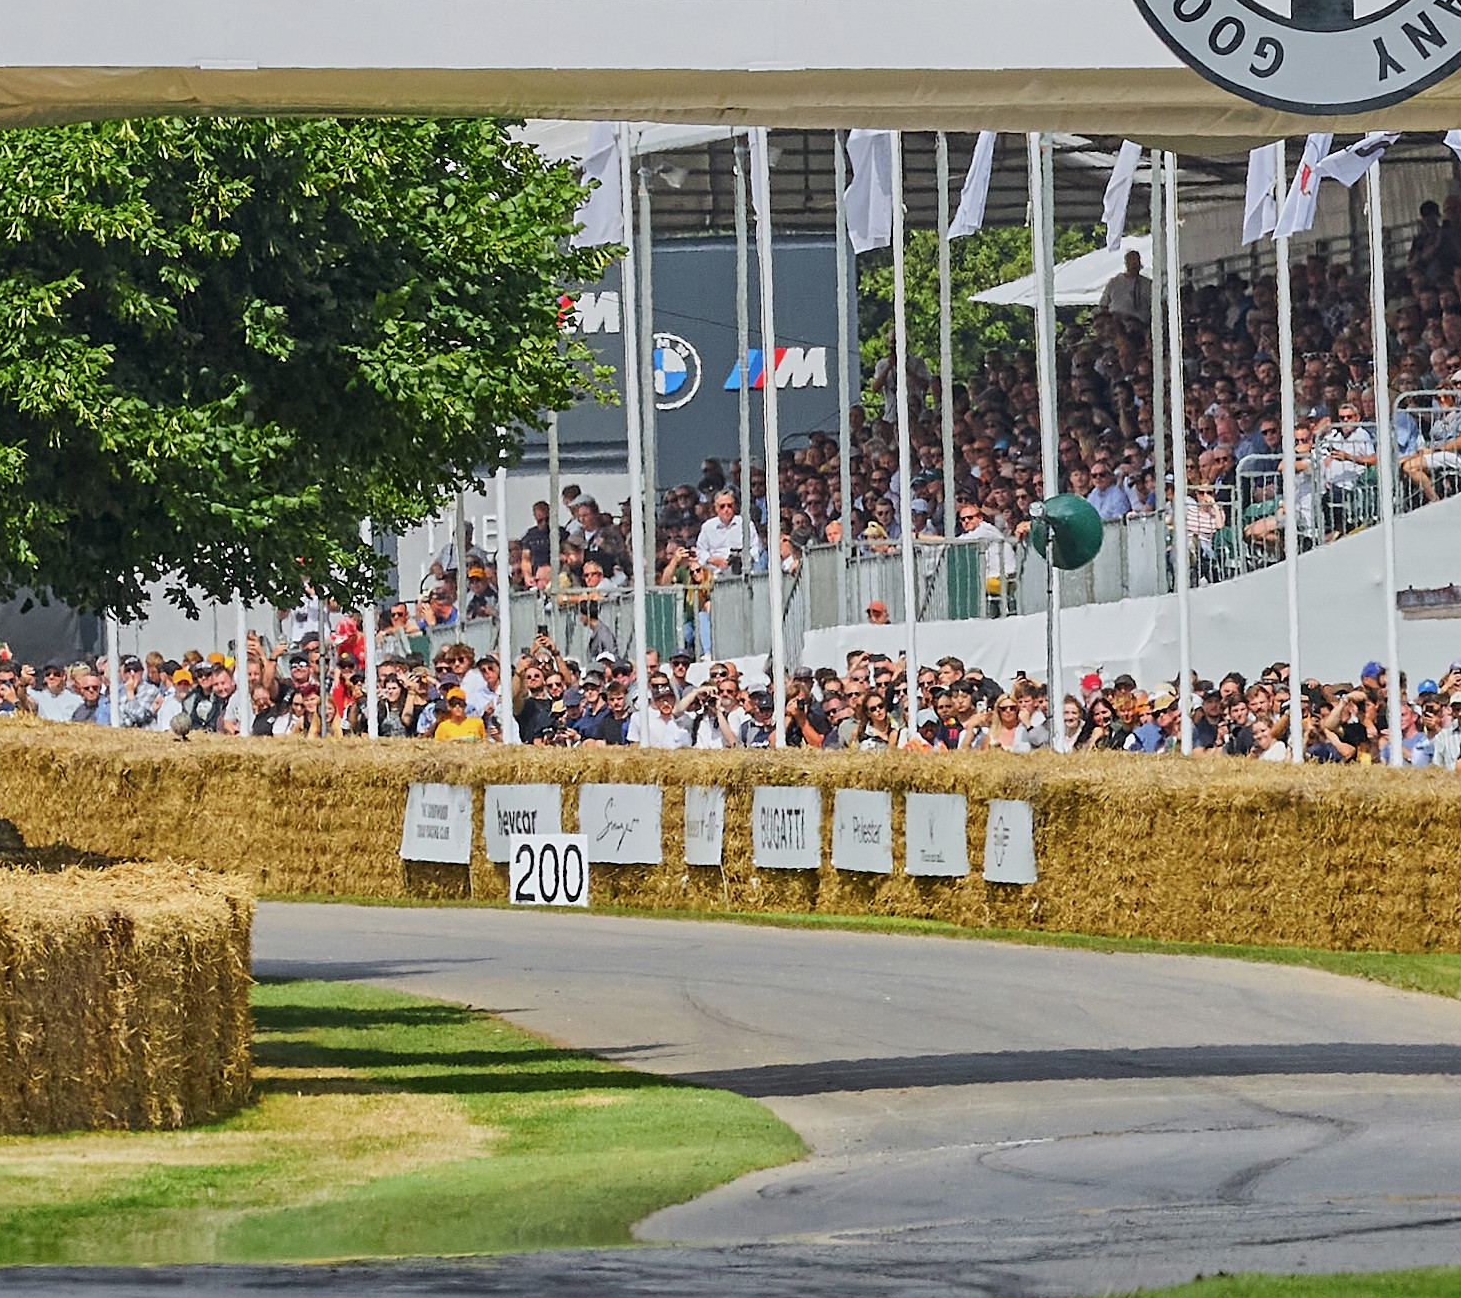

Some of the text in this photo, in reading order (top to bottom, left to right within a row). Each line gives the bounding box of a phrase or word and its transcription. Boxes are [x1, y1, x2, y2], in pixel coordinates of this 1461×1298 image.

[495, 798, 538, 836] heycar
[760, 808, 805, 850] BUGATTI
[515, 843, 584, 902] 200
